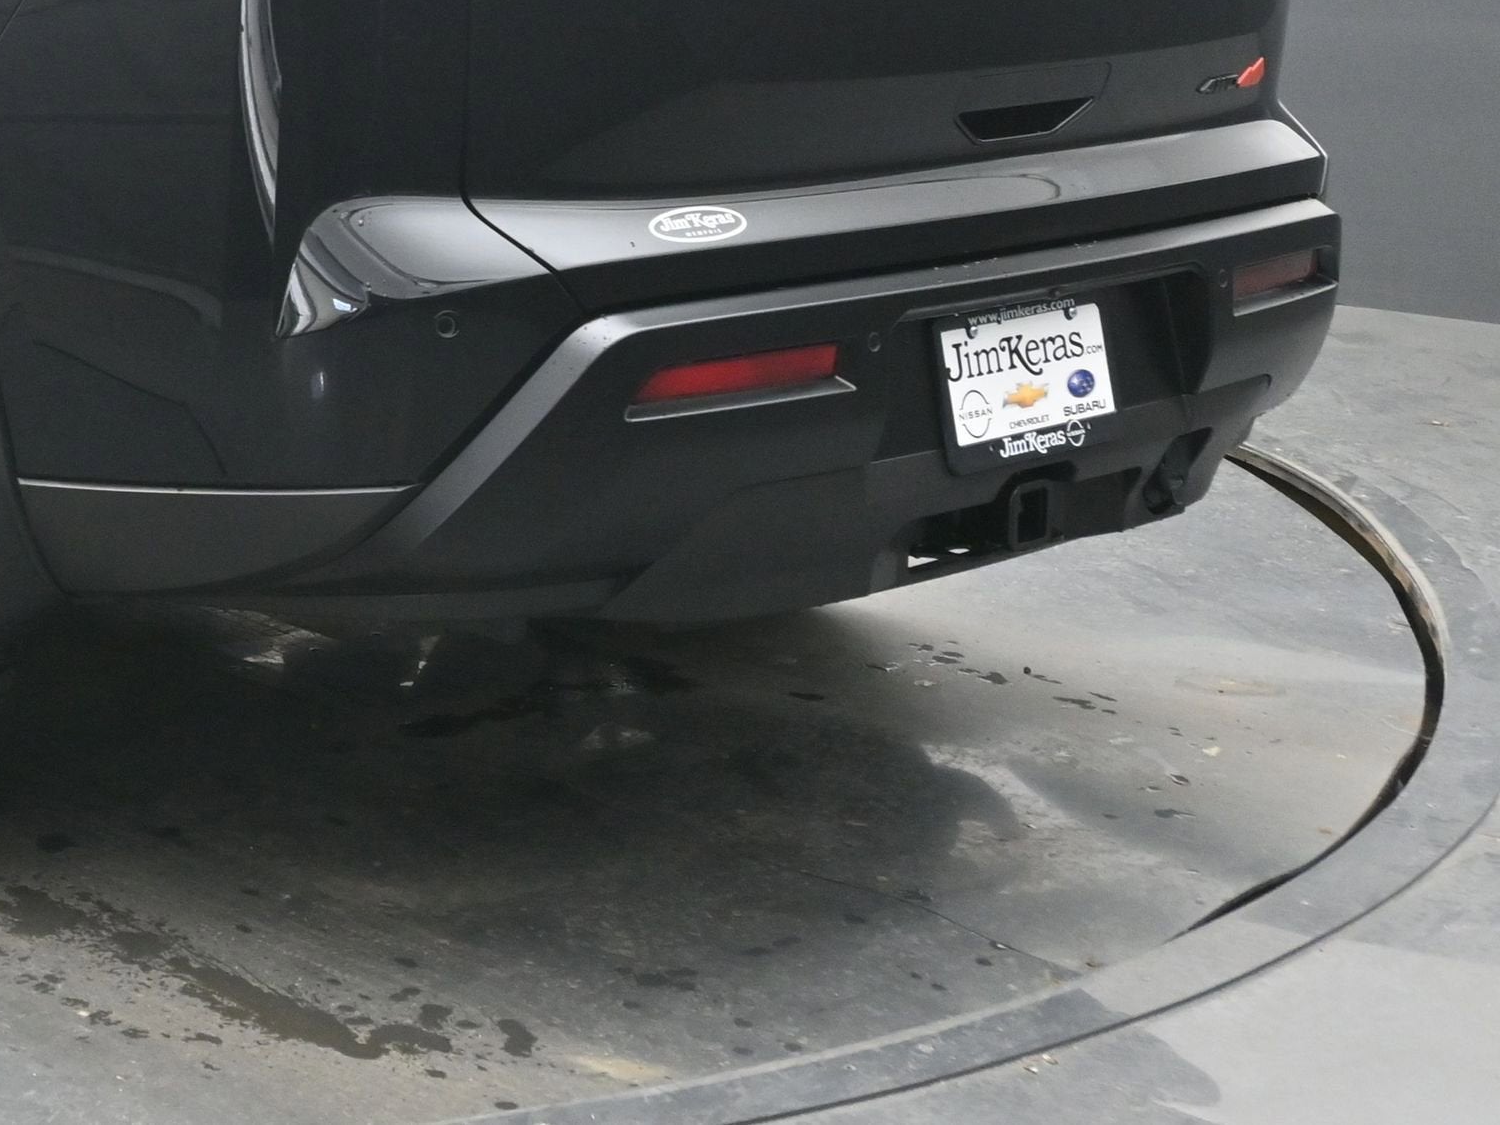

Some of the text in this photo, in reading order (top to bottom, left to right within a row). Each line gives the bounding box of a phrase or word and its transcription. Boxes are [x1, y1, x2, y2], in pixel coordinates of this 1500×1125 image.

[967, 298, 1075, 326] www.jimkeras.com
[958, 407, 994, 421] NISSAN
[1063, 399, 1106, 417] SUBARU
[1009, 414, 1050, 429] CHEVROLET
